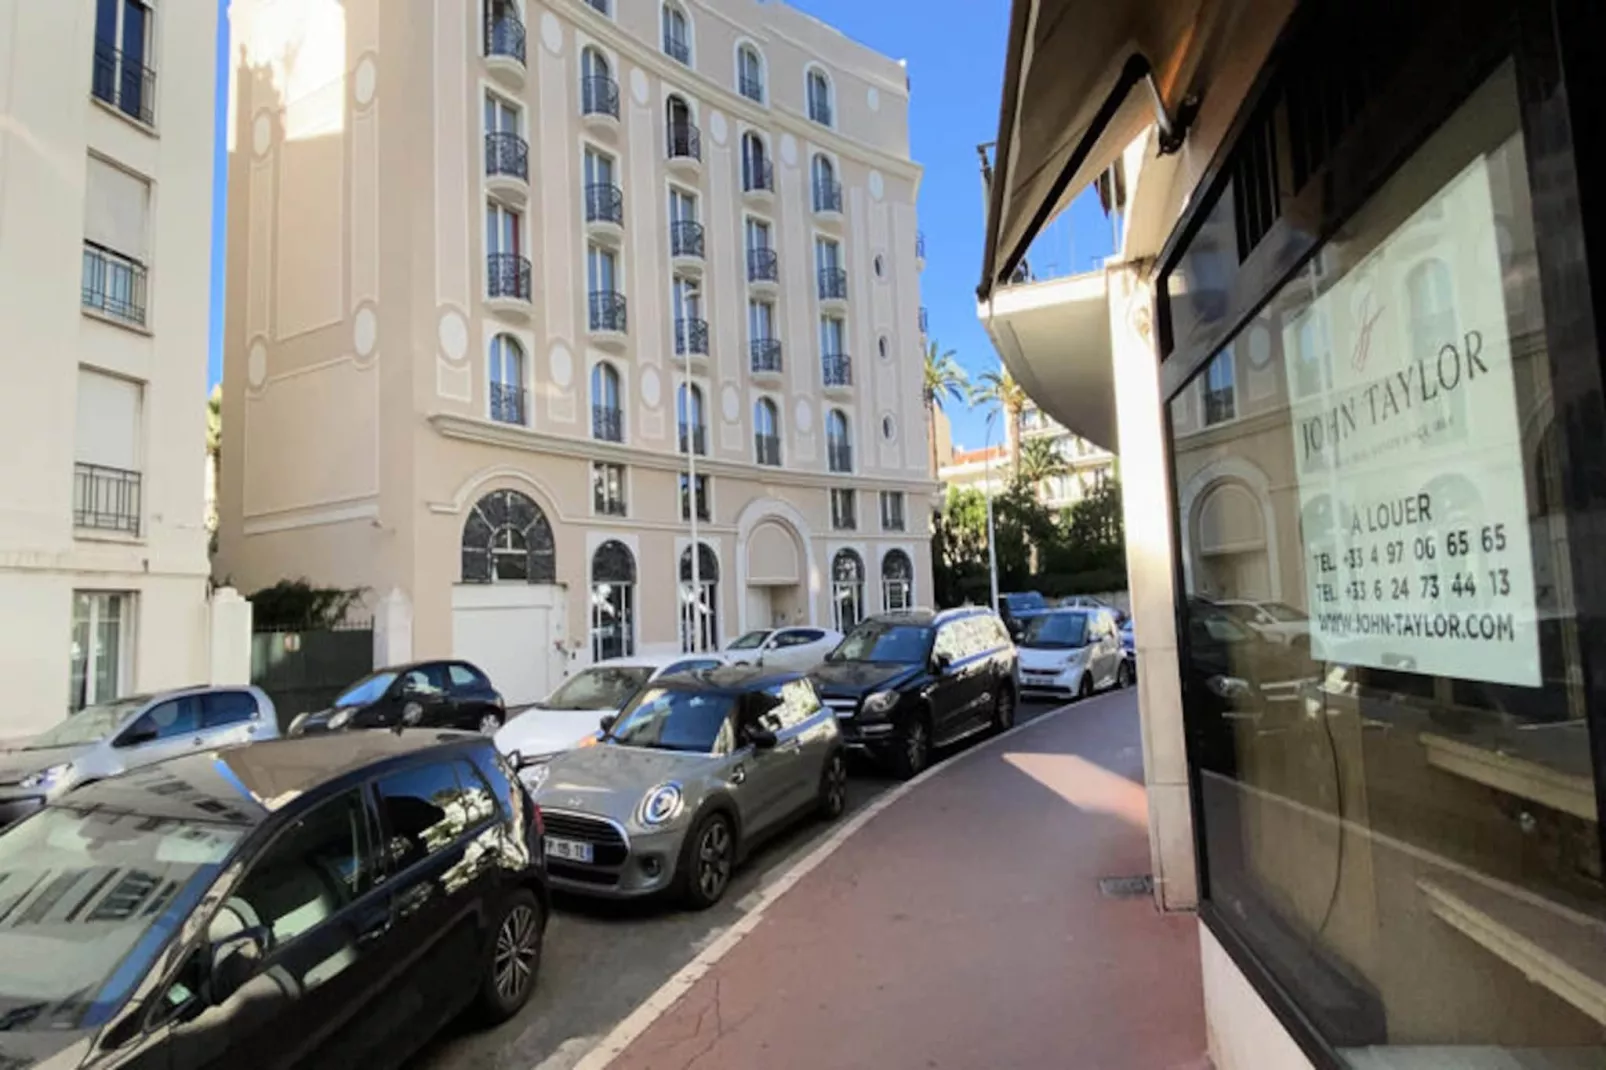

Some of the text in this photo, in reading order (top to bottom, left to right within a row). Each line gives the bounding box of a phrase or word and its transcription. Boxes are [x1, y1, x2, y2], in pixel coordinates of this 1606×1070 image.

[1302, 395, 1356, 460] JOHN
[1364, 329, 1488, 426] TAYLOR
[1367, 493, 1432, 533] LOUER
[1343, 547, 1364, 570] +33
[1370, 544, 1379, 565] 4
[1386, 541, 1404, 564] 97
[1446, 530, 1469, 557] 65
[1481, 524, 1507, 552] 65
[1345, 580, 1366, 601] +33
[1373, 579, 1383, 600] 6
[1391, 576, 1409, 600] 24
[1420, 574, 1440, 599] 73
[1451, 571, 1476, 598] 44
[1488, 568, 1511, 596] 13
